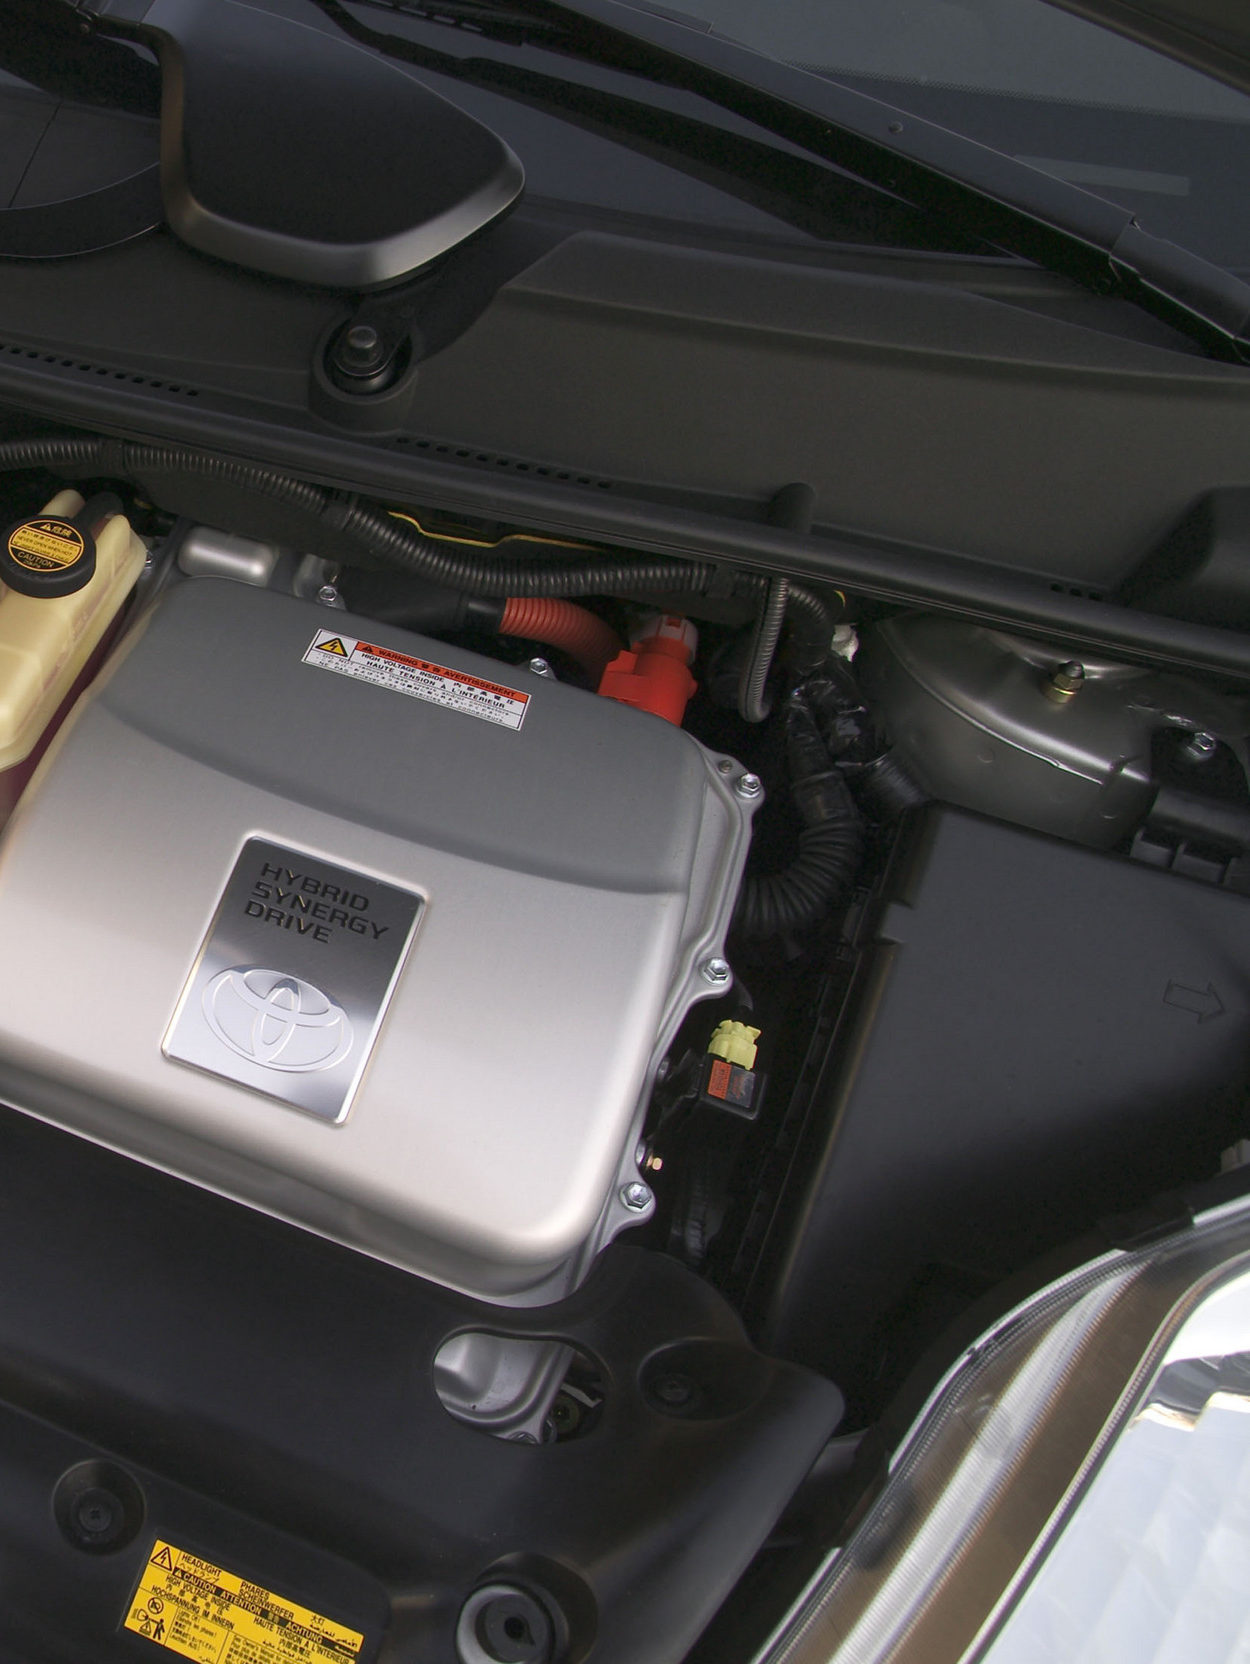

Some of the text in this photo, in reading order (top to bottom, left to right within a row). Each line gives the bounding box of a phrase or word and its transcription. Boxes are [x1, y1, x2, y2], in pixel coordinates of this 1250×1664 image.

[18, 552, 54, 567] CAUTION
[360, 652, 381, 662] HIGH
[382, 659, 416, 673] VOLTAGE
[418, 670, 445, 682] INSIDE
[365, 660, 394, 672] HAUTE
[398, 670, 436, 686] TENSION
[377, 649, 418, 666] WARNING
[443, 670, 516, 697] AVERTISSEMENT
[261, 862, 369, 913] HYBRID
[244, 900, 333, 944] DRIVE
[251, 881, 390, 940] SYNERGY
[181, 1553, 222, 1577] HEADLIGHT
[165, 1574, 181, 1587] HIGH
[181, 1582, 209, 1600] VOLTAGE
[209, 1595, 231, 1611] INSIDE
[182, 1572, 217, 1593] CAUTION
[240, 1580, 270, 1600] PHARES
[150, 1584, 201, 1614] HOCHSPANNUNG
[210, 1613, 235, 1630] INNERN
[219, 1590, 262, 1616] ATTENTION
[237, 1588, 295, 1620] SCHEINWERFER
[252, 1615, 274, 1632] HAUTE
[274, 1626, 303, 1645] TENSION
[285, 1621, 323, 1644] ACHTUNG
